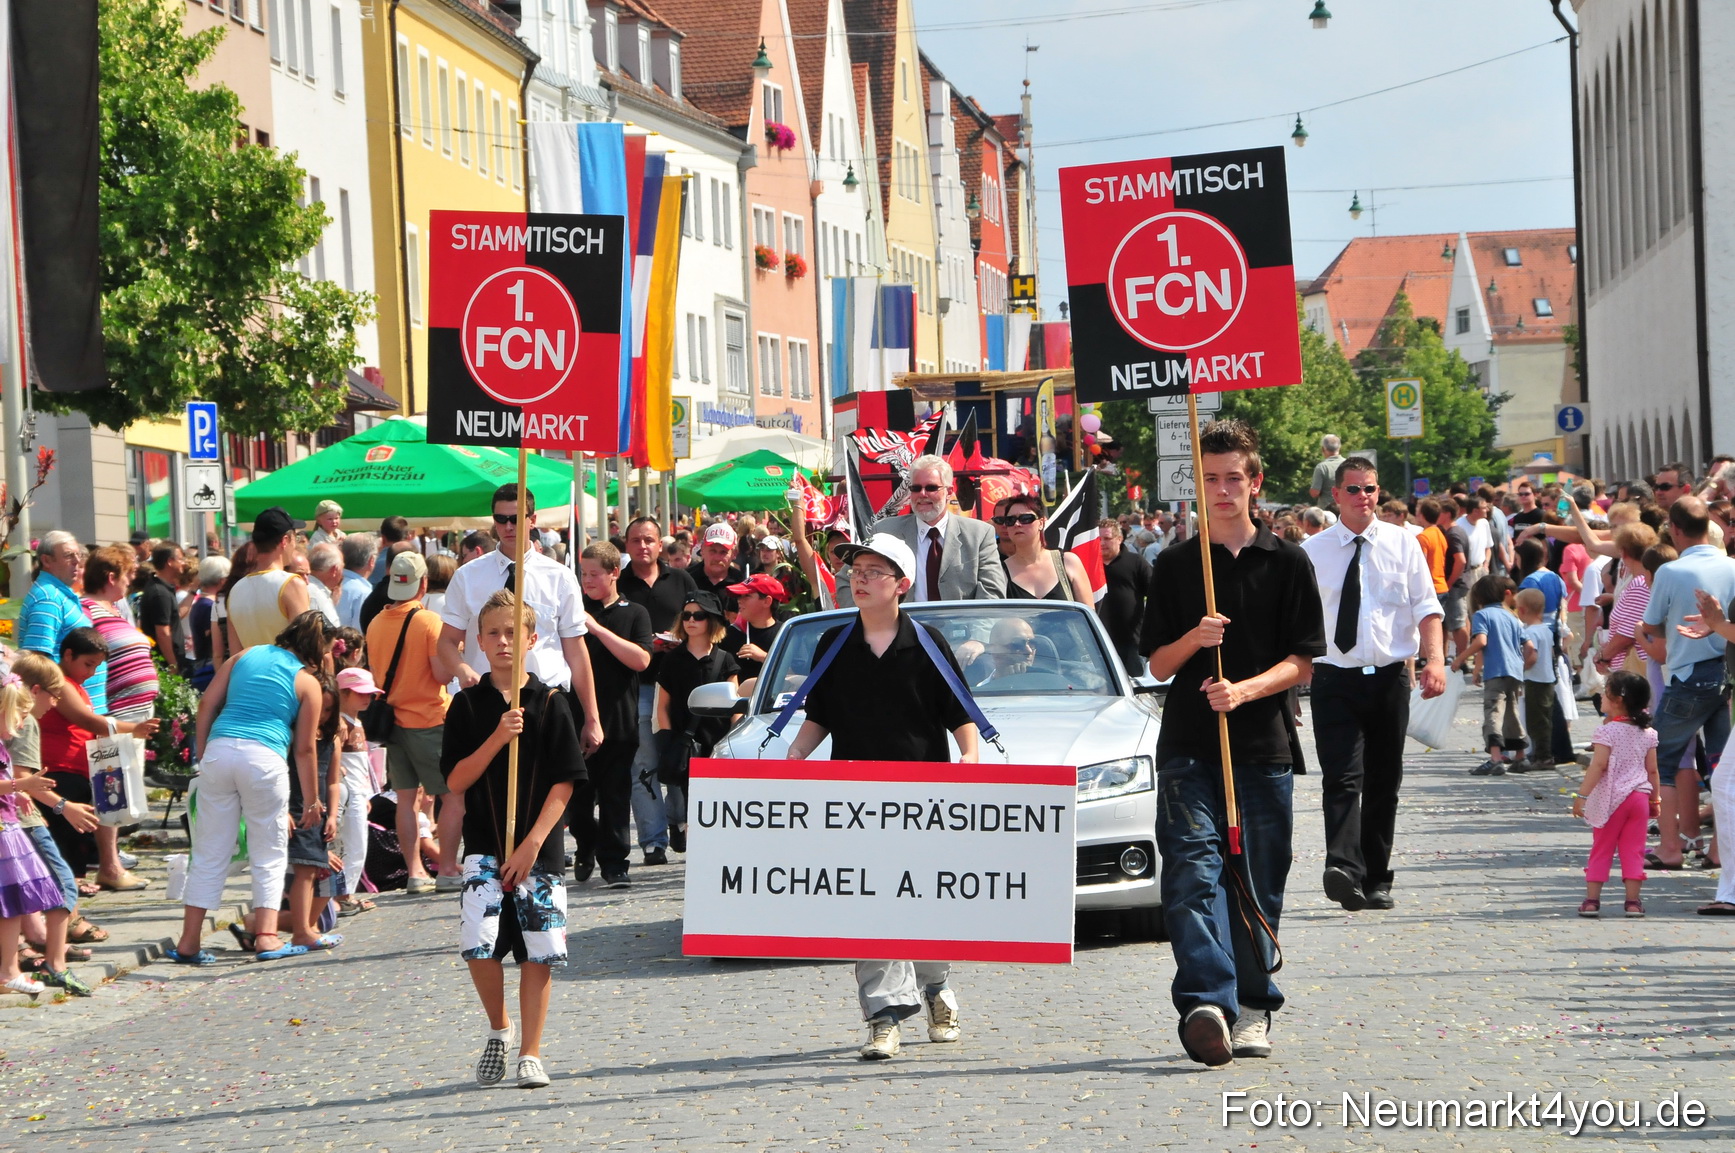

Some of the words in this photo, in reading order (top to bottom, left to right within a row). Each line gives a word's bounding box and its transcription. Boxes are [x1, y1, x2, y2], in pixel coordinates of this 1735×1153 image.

[1084, 161, 1264, 204] STAMMTISCH
[451, 223, 604, 254] STAMMTISCH
[1156, 224, 1192, 267] 1.
[506, 279, 534, 322] 1.
[1124, 268, 1233, 320] FCN
[475, 326, 566, 371] FCN
[1110, 351, 1265, 392] NEUMARKT
[456, 409, 589, 441] NEUMARKT
[313, 471, 425, 484] Lammsbräu
[333, 464, 415, 475] Neumarkter
[710, 529, 731, 540] CLUB
[697, 801, 809, 829] UNSER
[824, 798, 1066, 833] EX-PRÄSIDENT
[721, 866, 876, 897] MICHAEL
[896, 871, 922, 899] A.
[936, 872, 1027, 900] ROTH
